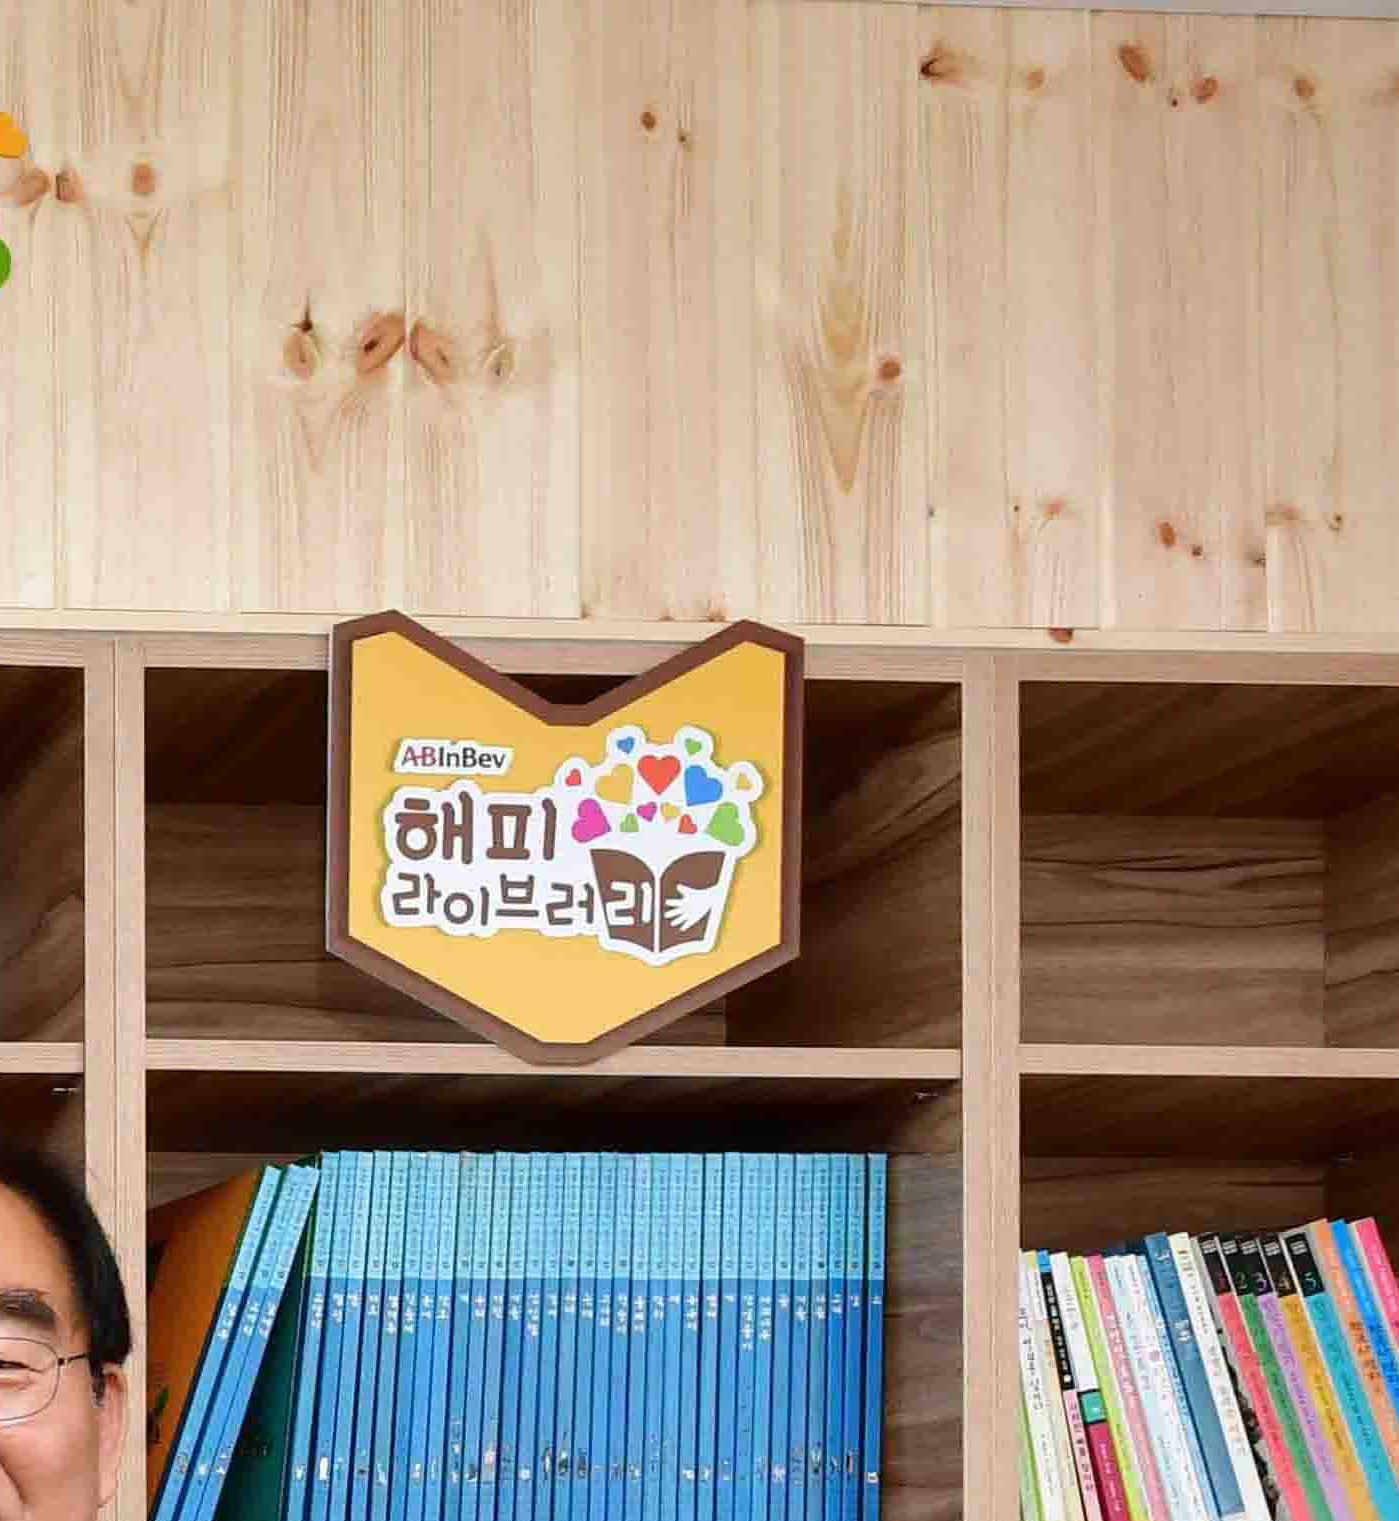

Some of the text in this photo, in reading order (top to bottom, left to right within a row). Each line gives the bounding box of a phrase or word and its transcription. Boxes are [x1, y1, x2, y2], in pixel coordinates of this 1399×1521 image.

[401, 744, 506, 770] ABInBev
[394, 791, 558, 866] 해피
[391, 873, 653, 927] 라이브러리
